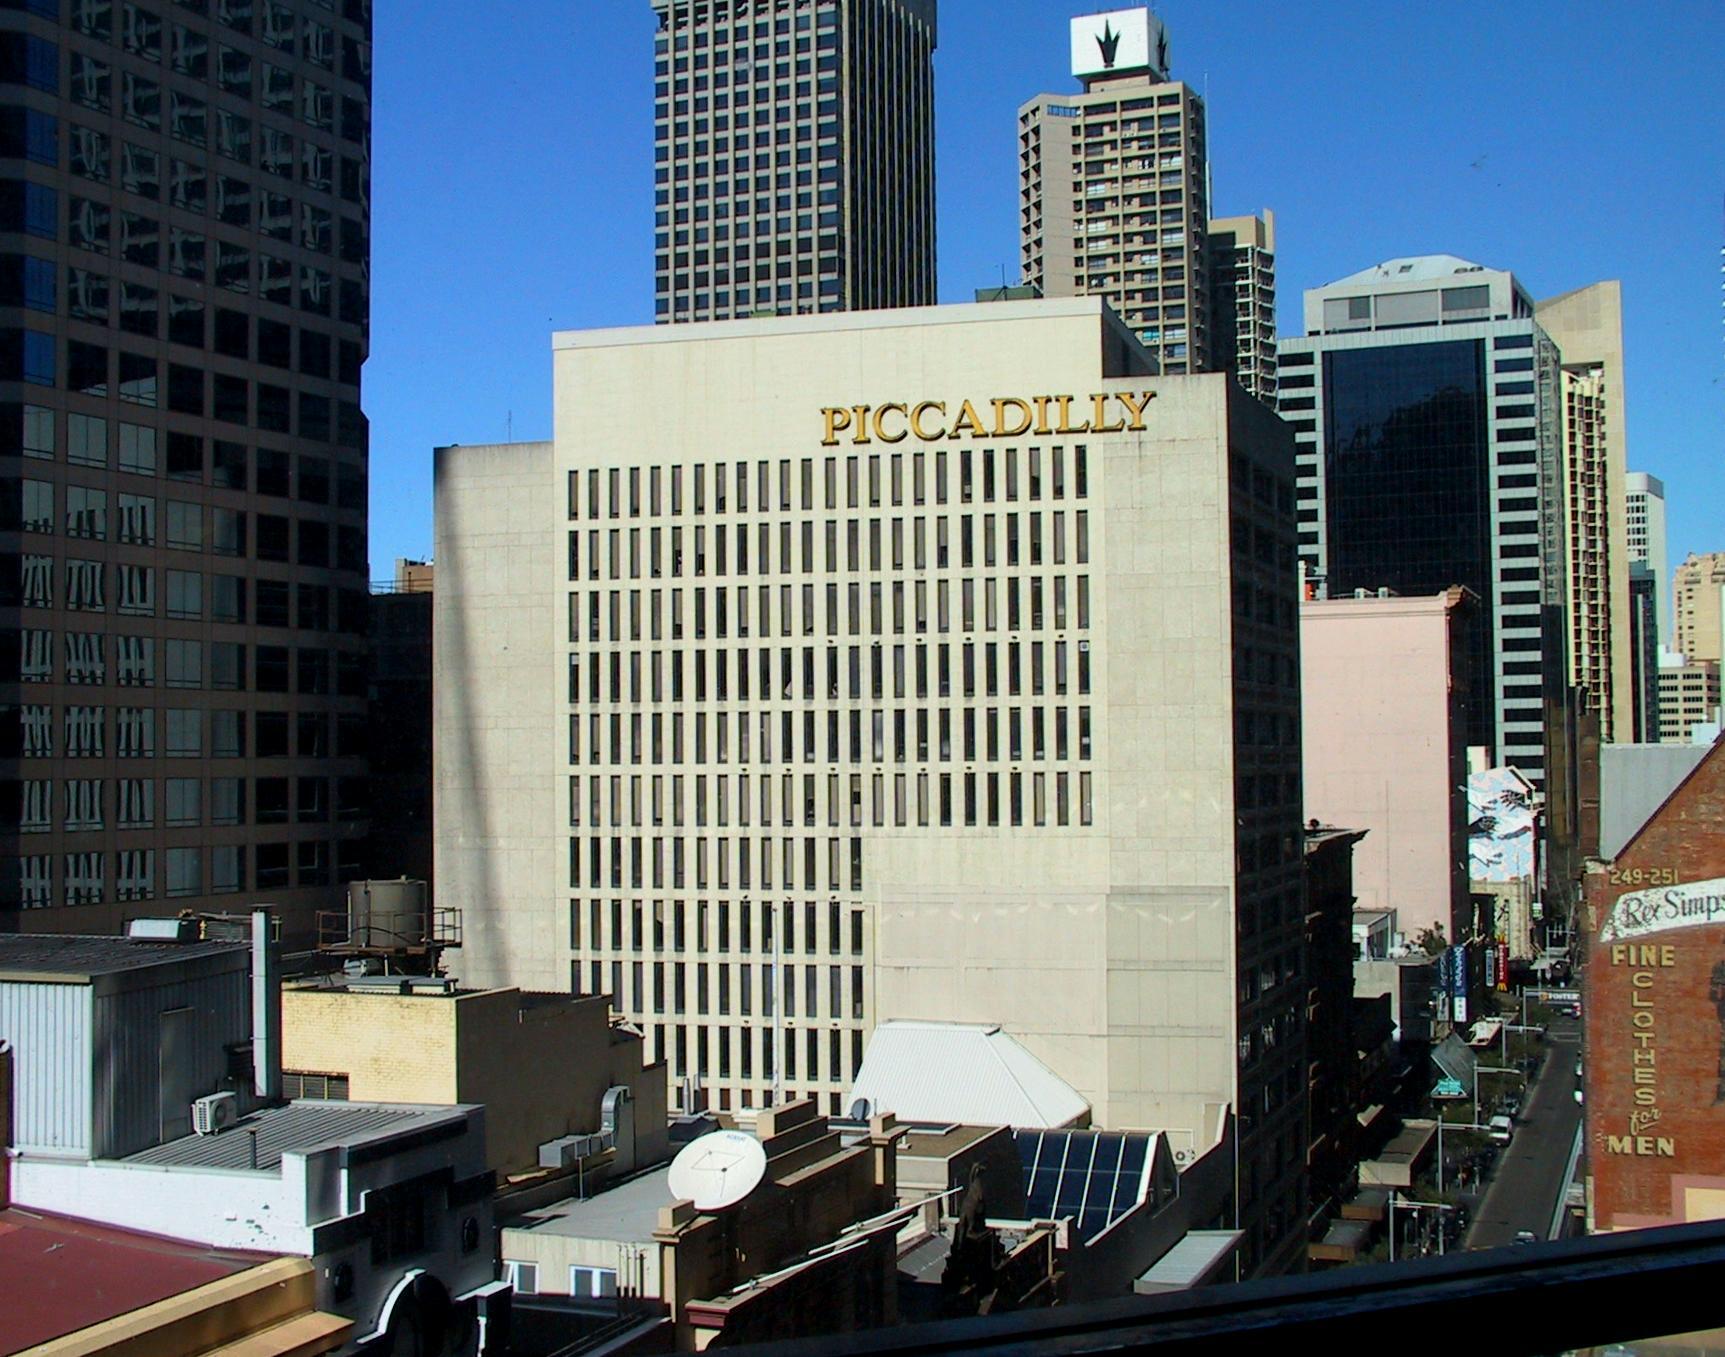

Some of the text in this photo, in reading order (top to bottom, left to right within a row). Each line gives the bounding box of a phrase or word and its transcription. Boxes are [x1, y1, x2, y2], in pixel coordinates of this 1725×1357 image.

[820, 390, 1157, 446] PICCADILLY
[1609, 867, 1680, 886] 249-251
[1620, 897, 1661, 927] Rex
[1611, 945, 1676, 967] FINE
[1632, 971, 1656, 1105] CLOTHES
[1629, 1107, 1662, 1136] for
[1607, 1135, 1675, 1157] MEN
